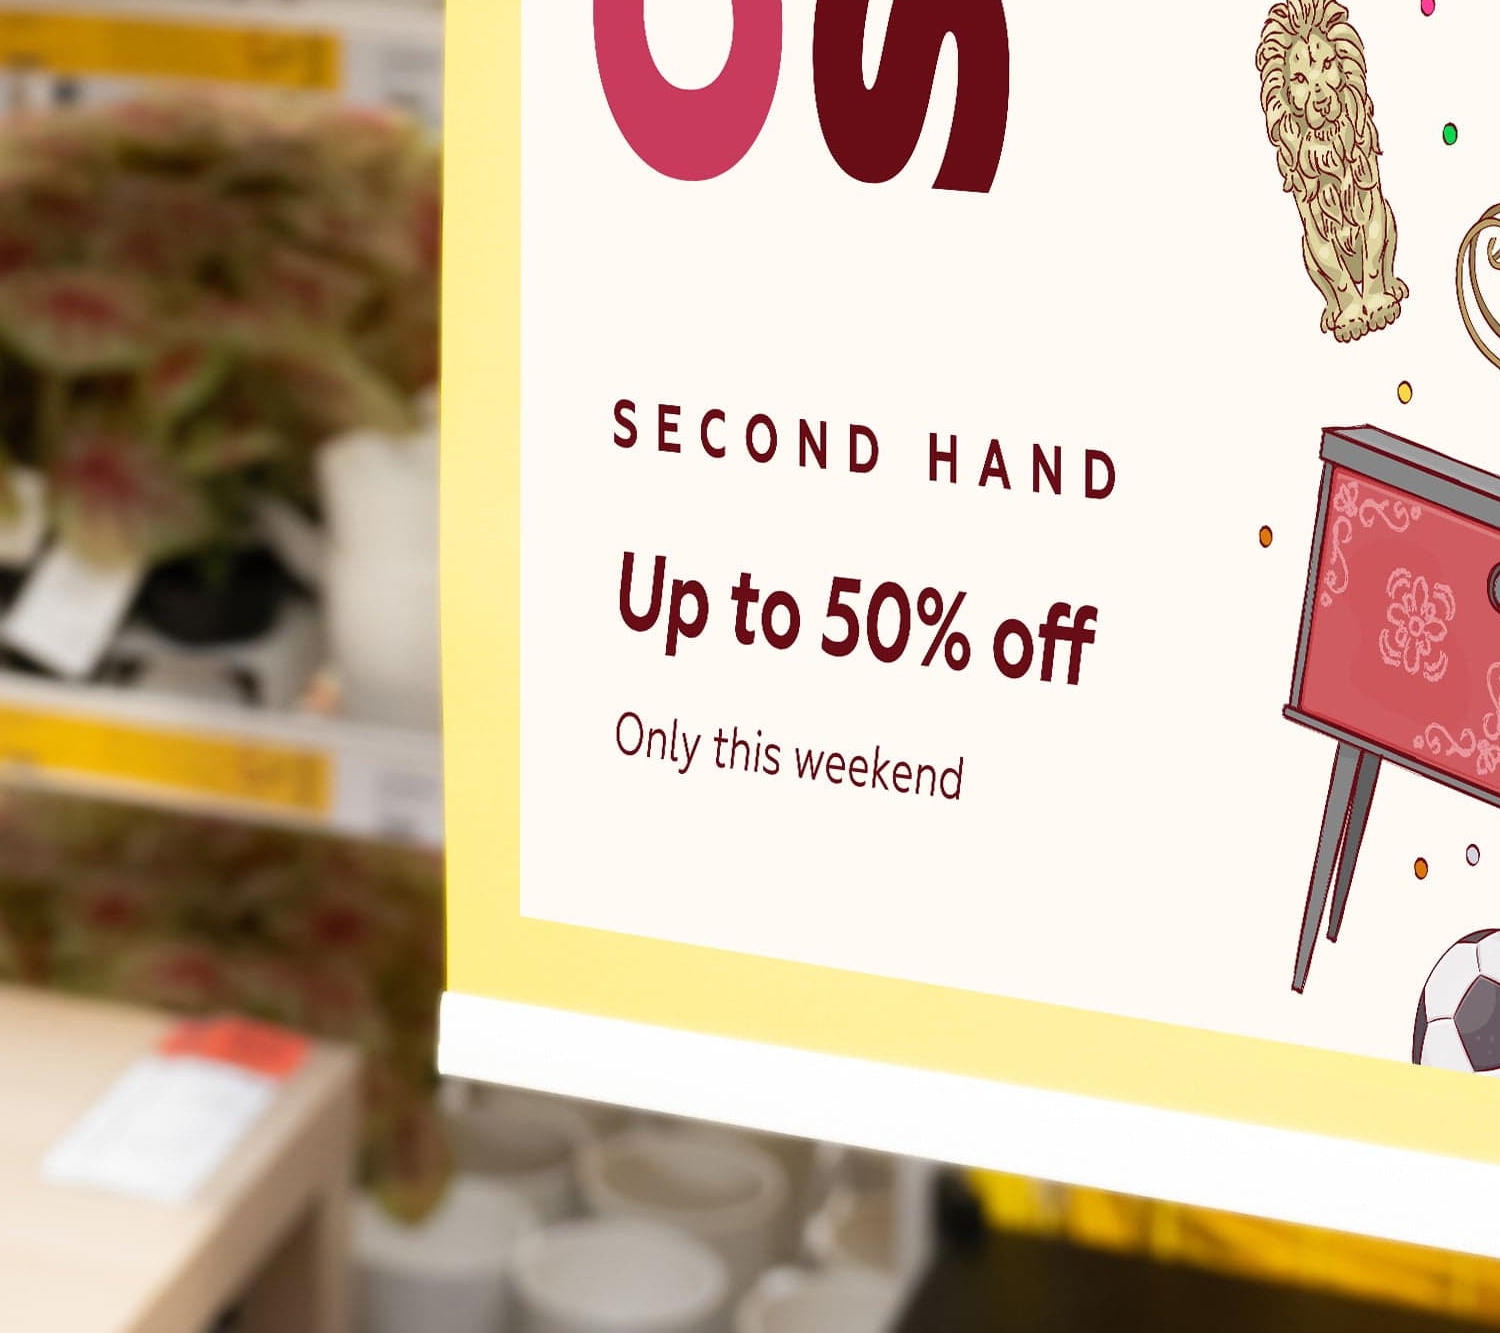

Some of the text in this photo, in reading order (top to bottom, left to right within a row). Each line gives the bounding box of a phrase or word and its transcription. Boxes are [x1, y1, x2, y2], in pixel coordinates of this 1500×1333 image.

[613, 398, 1117, 500] SECOND HAND
[619, 550, 1099, 686] Up to 50% off
[615, 711, 964, 801] Only this weekend
